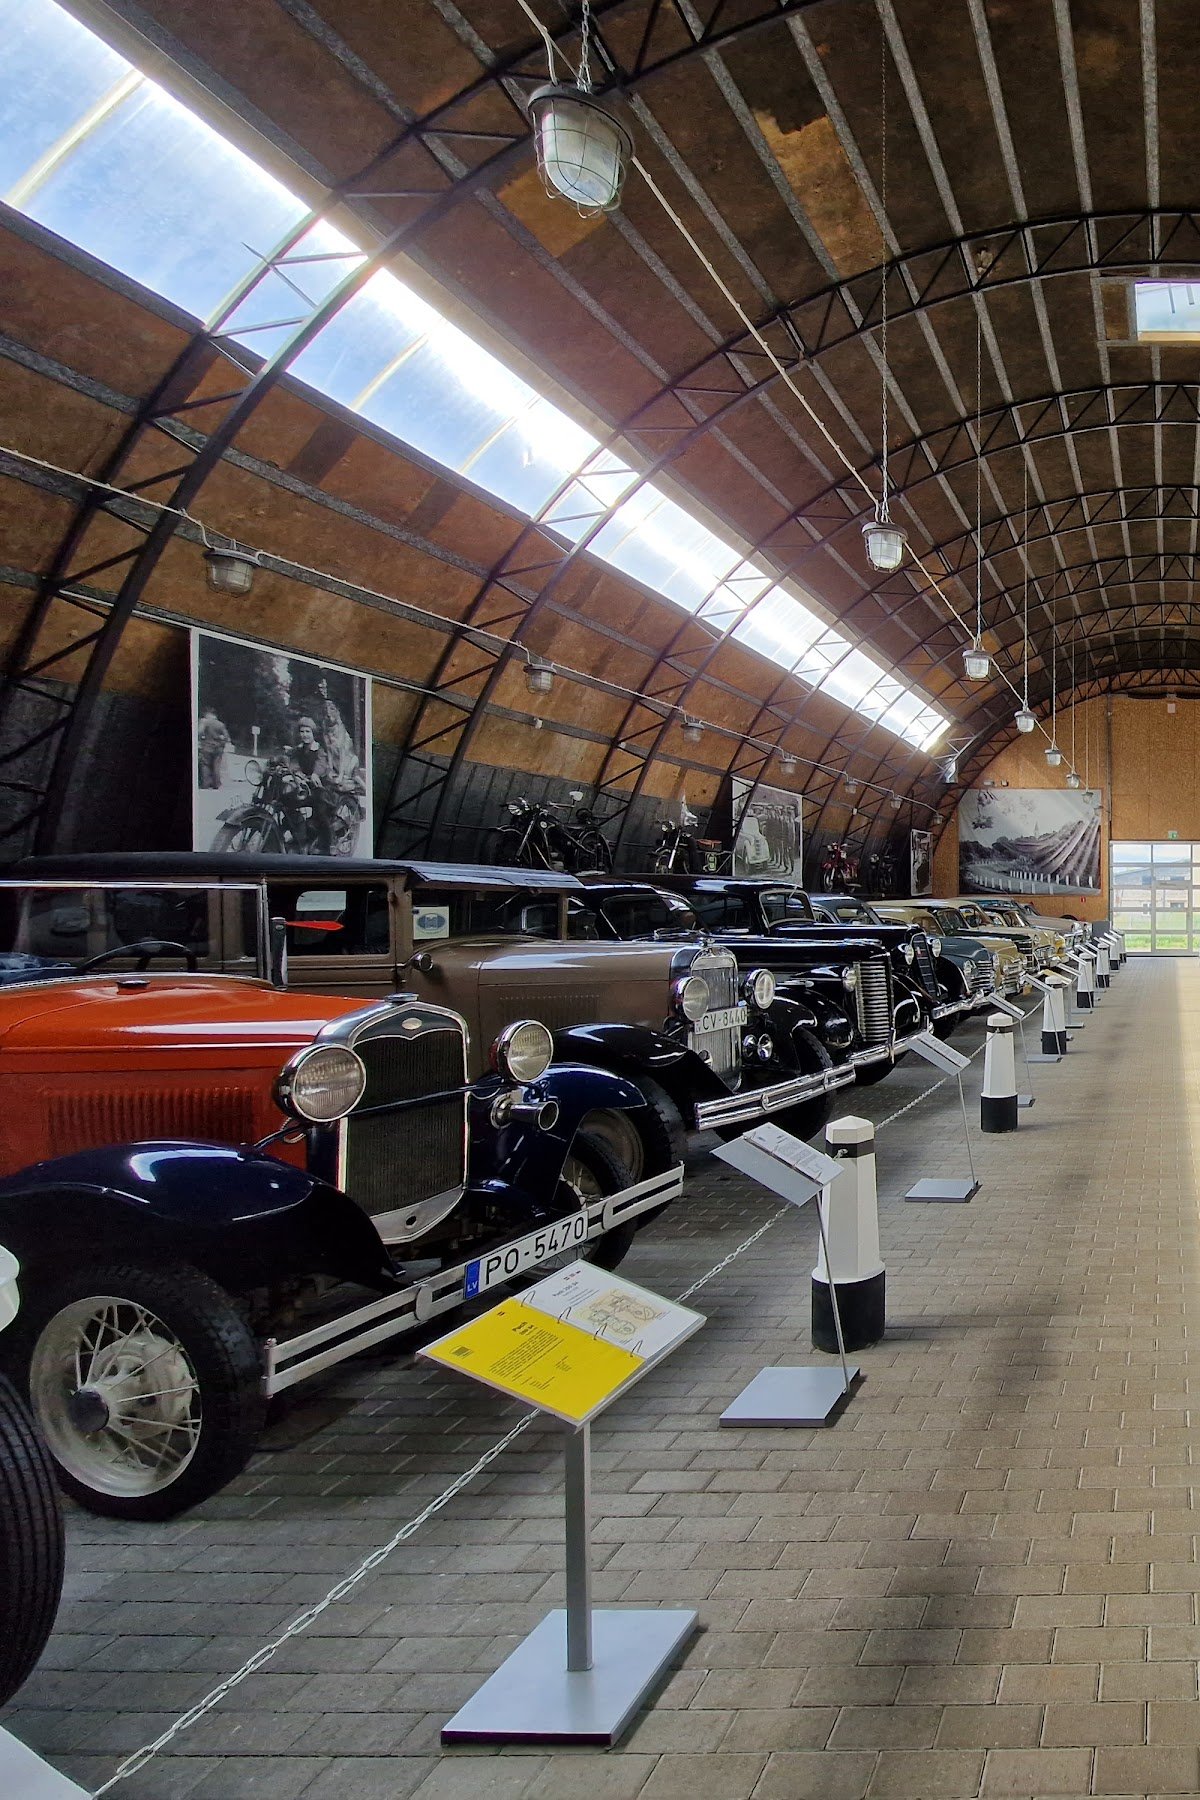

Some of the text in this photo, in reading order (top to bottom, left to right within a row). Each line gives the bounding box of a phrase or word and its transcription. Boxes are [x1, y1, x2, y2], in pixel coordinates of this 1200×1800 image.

[702, 1008, 746, 1030] CV-8440
[485, 1216, 584, 1285] PO-5470
[467, 1280, 478, 1292] LV
